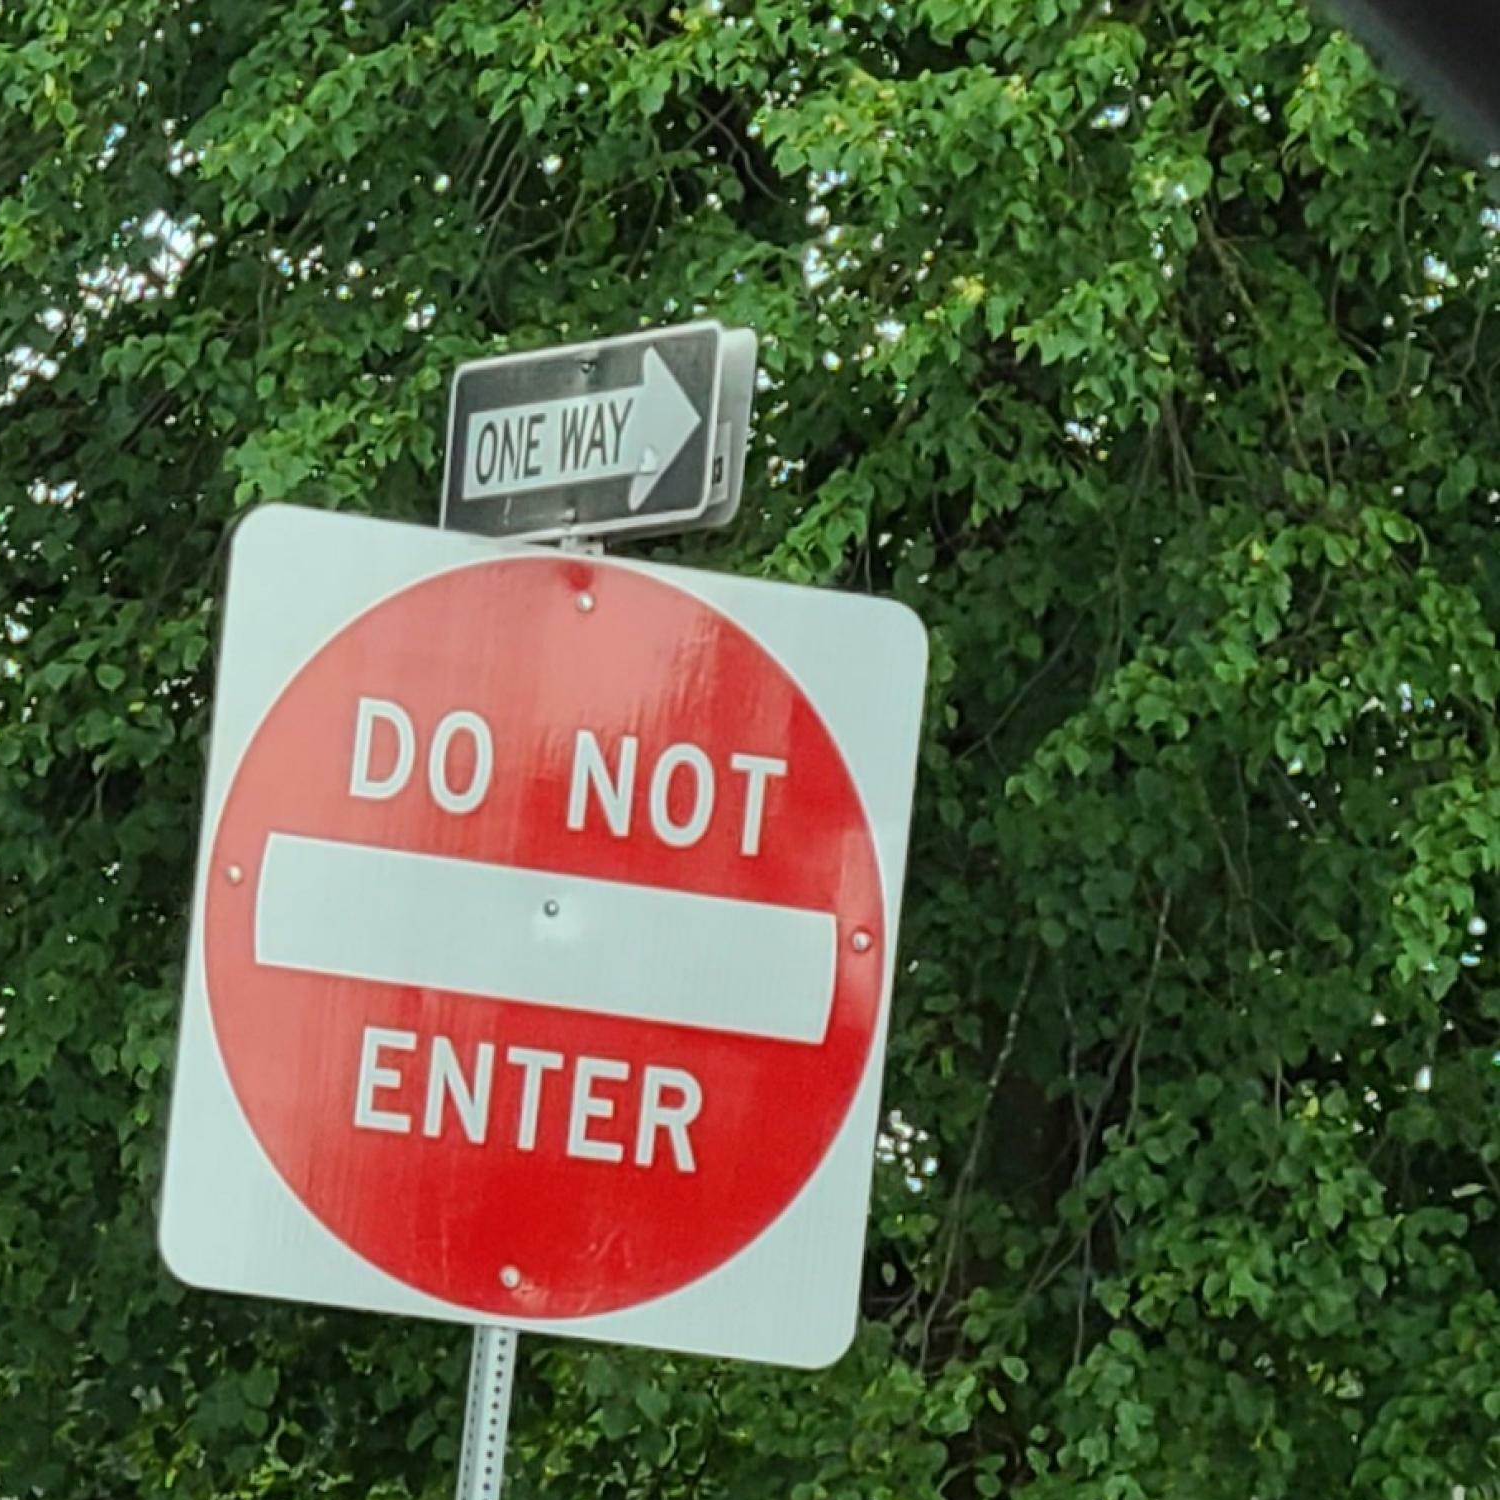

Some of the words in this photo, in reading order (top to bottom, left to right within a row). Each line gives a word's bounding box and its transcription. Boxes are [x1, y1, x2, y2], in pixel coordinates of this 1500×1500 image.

[476, 413, 546, 486] ONE
[560, 398, 633, 473] WAY
[349, 697, 494, 814] DO
[567, 729, 788, 857] NOT
[353, 1025, 704, 1173] ENTER
